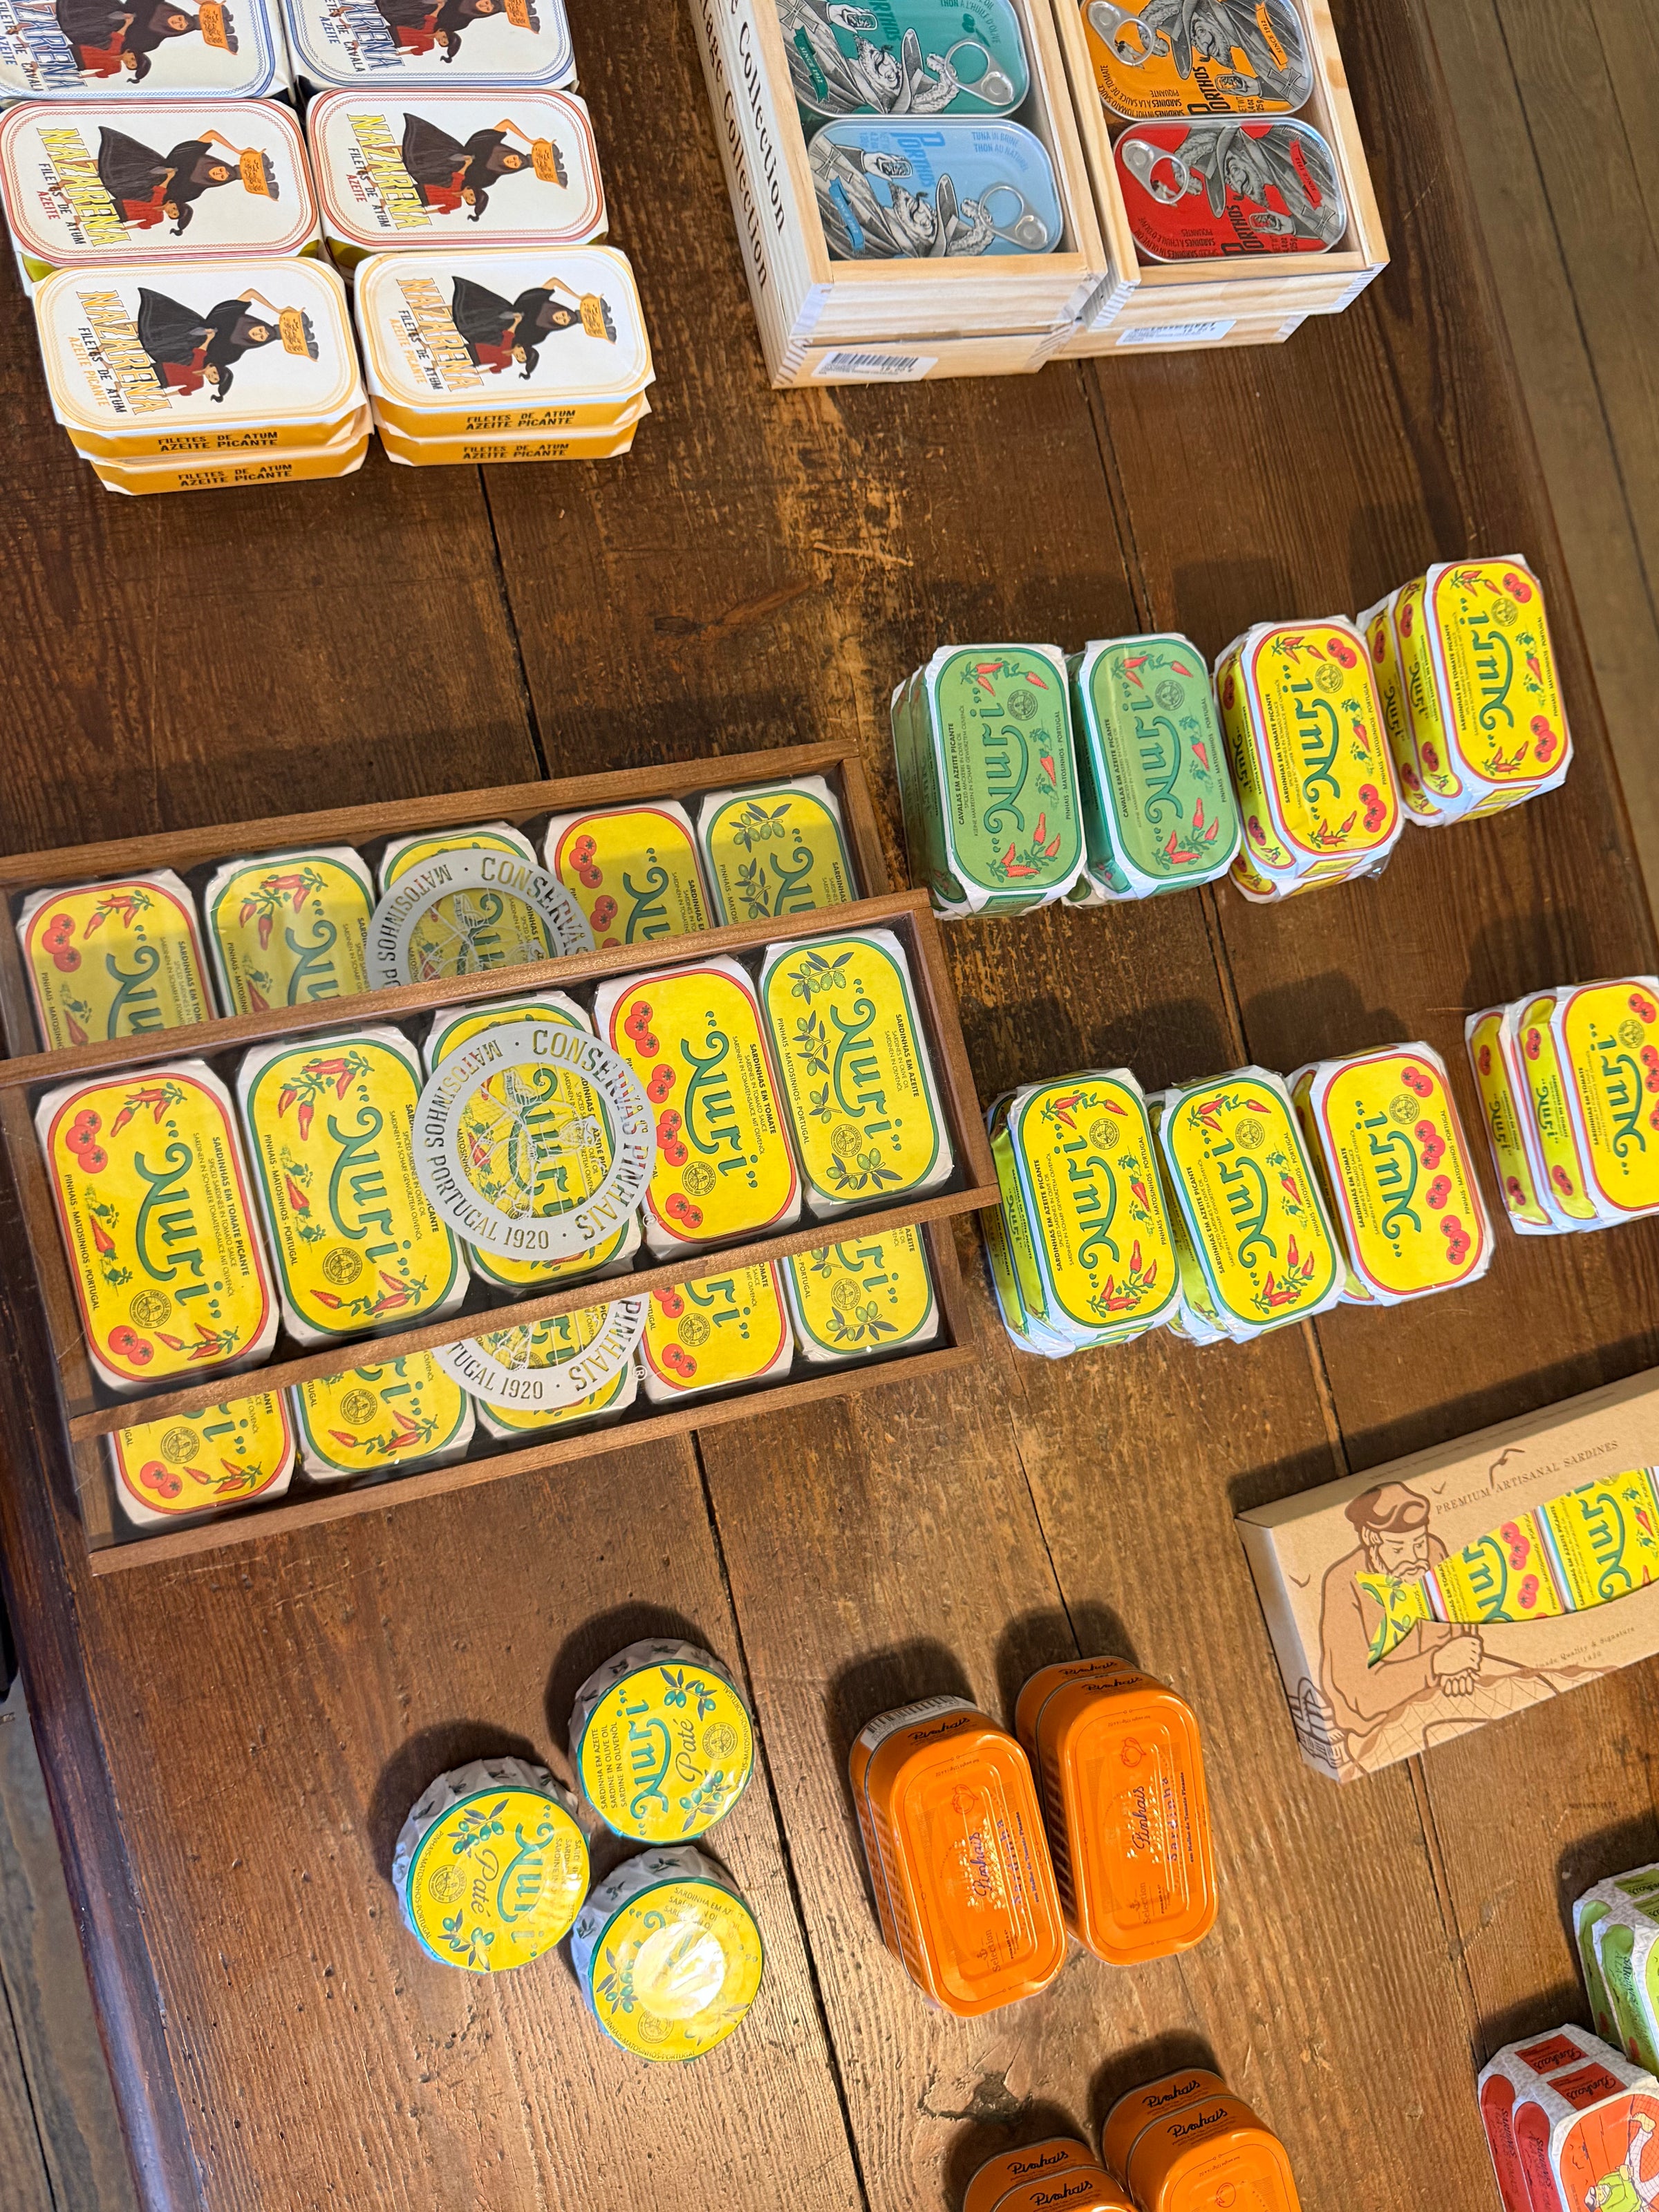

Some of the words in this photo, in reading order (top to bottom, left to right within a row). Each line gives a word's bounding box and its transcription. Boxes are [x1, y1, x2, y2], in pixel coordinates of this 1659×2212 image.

[319, 16, 340, 44] AZEITE
[335, 23, 350, 36] DE
[701, 0, 722, 82] tage
[1259, 19, 1271, 34] 1912
[342, 39, 366, 73] CAVALA
[1268, 34, 1282, 55] SINCE
[740, 21, 785, 236] Collection
[972, 131, 990, 140] TUNA
[37, 126, 131, 245] NAZARENA
[348, 113, 431, 228] NAZARENA
[346, 175, 367, 202] AZEITE
[724, 91, 767, 290] Collection
[35, 191, 62, 220] AZEITE
[363, 186, 377, 197] DE
[371, 205, 391, 228] ATUM
[57, 203, 72, 216] DE
[65, 219, 86, 245] ATUM
[1221, 205, 1273, 256] PORTHOS
[395, 276, 485, 391] NAZARENA
[77, 289, 173, 413] NAZARENA
[65, 335, 91, 366] AZEITE
[82, 368, 112, 406] PICANTE
[415, 348, 429, 359] DE
[423, 364, 443, 391] ATUM
[97, 367, 111, 380] DE
[106, 388, 128, 415] ATUM
[1265, 693, 1275, 722] PICANTE
[948, 722, 957, 756] PICANTE
[1105, 718, 1116, 751] PICANTE
[1271, 724, 1280, 750] TOMATE
[951, 758, 959, 778] AZEITE
[1111, 752, 1120, 773] AZEITE
[1275, 751, 1282, 762] EM
[953, 780, 961, 790] EM
[1115, 774, 1122, 785] EM
[1277, 763, 1290, 803] SARDINHAS
[955, 792, 964, 825] CAVALAS
[1117, 786, 1128, 818] CAVALAS
[830, 861, 848, 902] SARDINHAS
[378, 864, 453, 961] MATOSINHOS
[895, 1013, 911, 1058] SARDINHAS
[750, 1042, 767, 1088] SARDINHAS
[904, 1058, 914, 1070] EM
[426, 1040, 503, 1148] MATOSINHOS
[533, 1029, 648, 1135] CONSERVAS
[759, 1089, 769, 1101] EM
[777, 1018, 789, 1047] PINHAIS
[784, 1052, 799, 1100] MATOSINHOS
[794, 1106, 808, 1144] PORTUGAL
[907, 1071, 919, 1097] AZEITE
[762, 1102, 776, 1134] TOMATE
[212, 1136, 229, 1187] SARDINHAS
[1138, 1136, 1150, 1168] PORTUGAL
[1340, 1147, 1353, 1176] TOMATE
[576, 1142, 648, 1241] PINHAIS
[1033, 1159, 1046, 1191] PICANTE
[1185, 1165, 1199, 1195] PICANTE
[1348, 1177, 1355, 1187] EM
[223, 1188, 232, 1201] EM
[265, 1134, 278, 1164] PINHAIS
[272, 1169, 289, 1220] MATOSINHOS
[283, 1226, 298, 1266] PORTUGAL
[427, 1155, 498, 1241] PORTUGAL
[504, 1227, 549, 1249] 1920
[1040, 1192, 1051, 1215] AZEITE
[1145, 1172, 1159, 1215] MATOSINHOS
[1195, 1195, 1208, 1220] AZEITE
[1350, 1188, 1365, 1228] SARDINHAS
[227, 1204, 241, 1237] TOMATE
[1045, 1217, 1053, 1228] EM
[1155, 1219, 1165, 1245] PINHAIS
[1203, 1221, 1211, 1232] EM
[65, 1173, 77, 1204] PINHAIS
[73, 1210, 89, 1263] MATOSINHOS
[84, 1269, 99, 1310] PORTUGAL
[234, 1239, 249, 1276] PICANTE
[1048, 1228, 1062, 1271] SARDINHAS
[1206, 1232, 1224, 1274] SARDINHAS
[798, 1262, 812, 1298] PORTUGAL
[569, 1300, 641, 1391] PINHAIS
[500, 1378, 543, 1399] 1920
[1434, 1485, 1491, 1515] PREMIUM
[1492, 1460, 1560, 1493] ARTISANAL
[1562, 1438, 1619, 1468] SARDINES
[1060, 1660, 1118, 1676] Pinhais
[1083, 1675, 1143, 1692] Pinhais
[590, 1727, 601, 1753] AZEITE
[601, 1724, 609, 1736] OIL
[610, 1721, 622, 1760] OLIVENÖL
[908, 1716, 971, 1742] Pinhais
[593, 1755, 602, 1767] EM
[602, 1738, 612, 1762] OLIVE
[615, 1762, 624, 1771] IN
[676, 1719, 704, 1782] Paté
[605, 1763, 613, 1772] IN
[595, 1769, 607, 1809] SARDINHA
[606, 1775, 617, 1808] SARDINE
[616, 1774, 627, 1807] SARDINE
[1129, 1785, 1150, 1849] Pinhais
[473, 1848, 500, 1915] Paté
[1533, 2045, 1582, 2075] Pinhais
[1143, 2080, 1201, 2108] Pinhais
[1566, 2072, 1617, 2106] Pinhais
[1168, 2108, 1228, 2137] Pinhais
[1007, 2150, 1069, 2175] Pinhais
[1030, 2180, 1094, 2206] Pinhais
